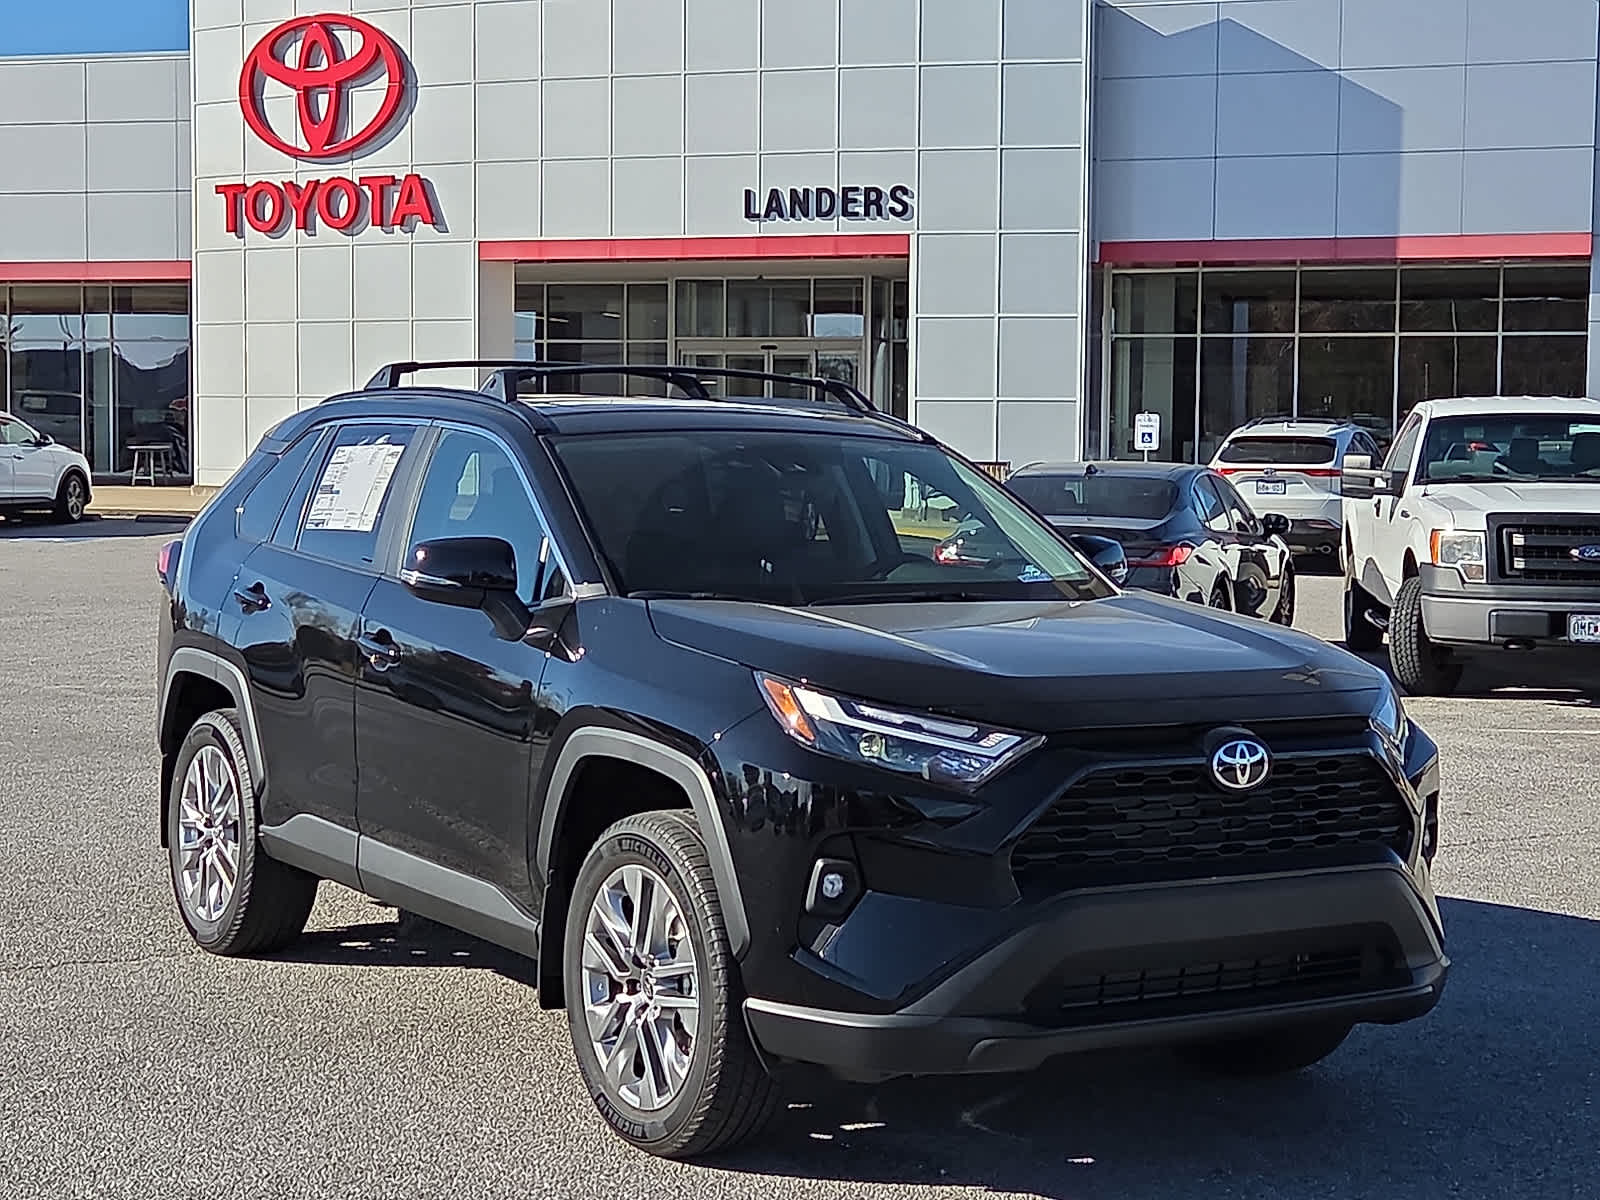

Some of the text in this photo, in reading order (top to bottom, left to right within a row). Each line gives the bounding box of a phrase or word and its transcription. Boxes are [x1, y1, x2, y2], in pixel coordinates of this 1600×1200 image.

[215, 174, 435, 233] TOYOTA
[744, 185, 910, 219] LANDERS
[621, 839, 669, 873] MICHELIN
